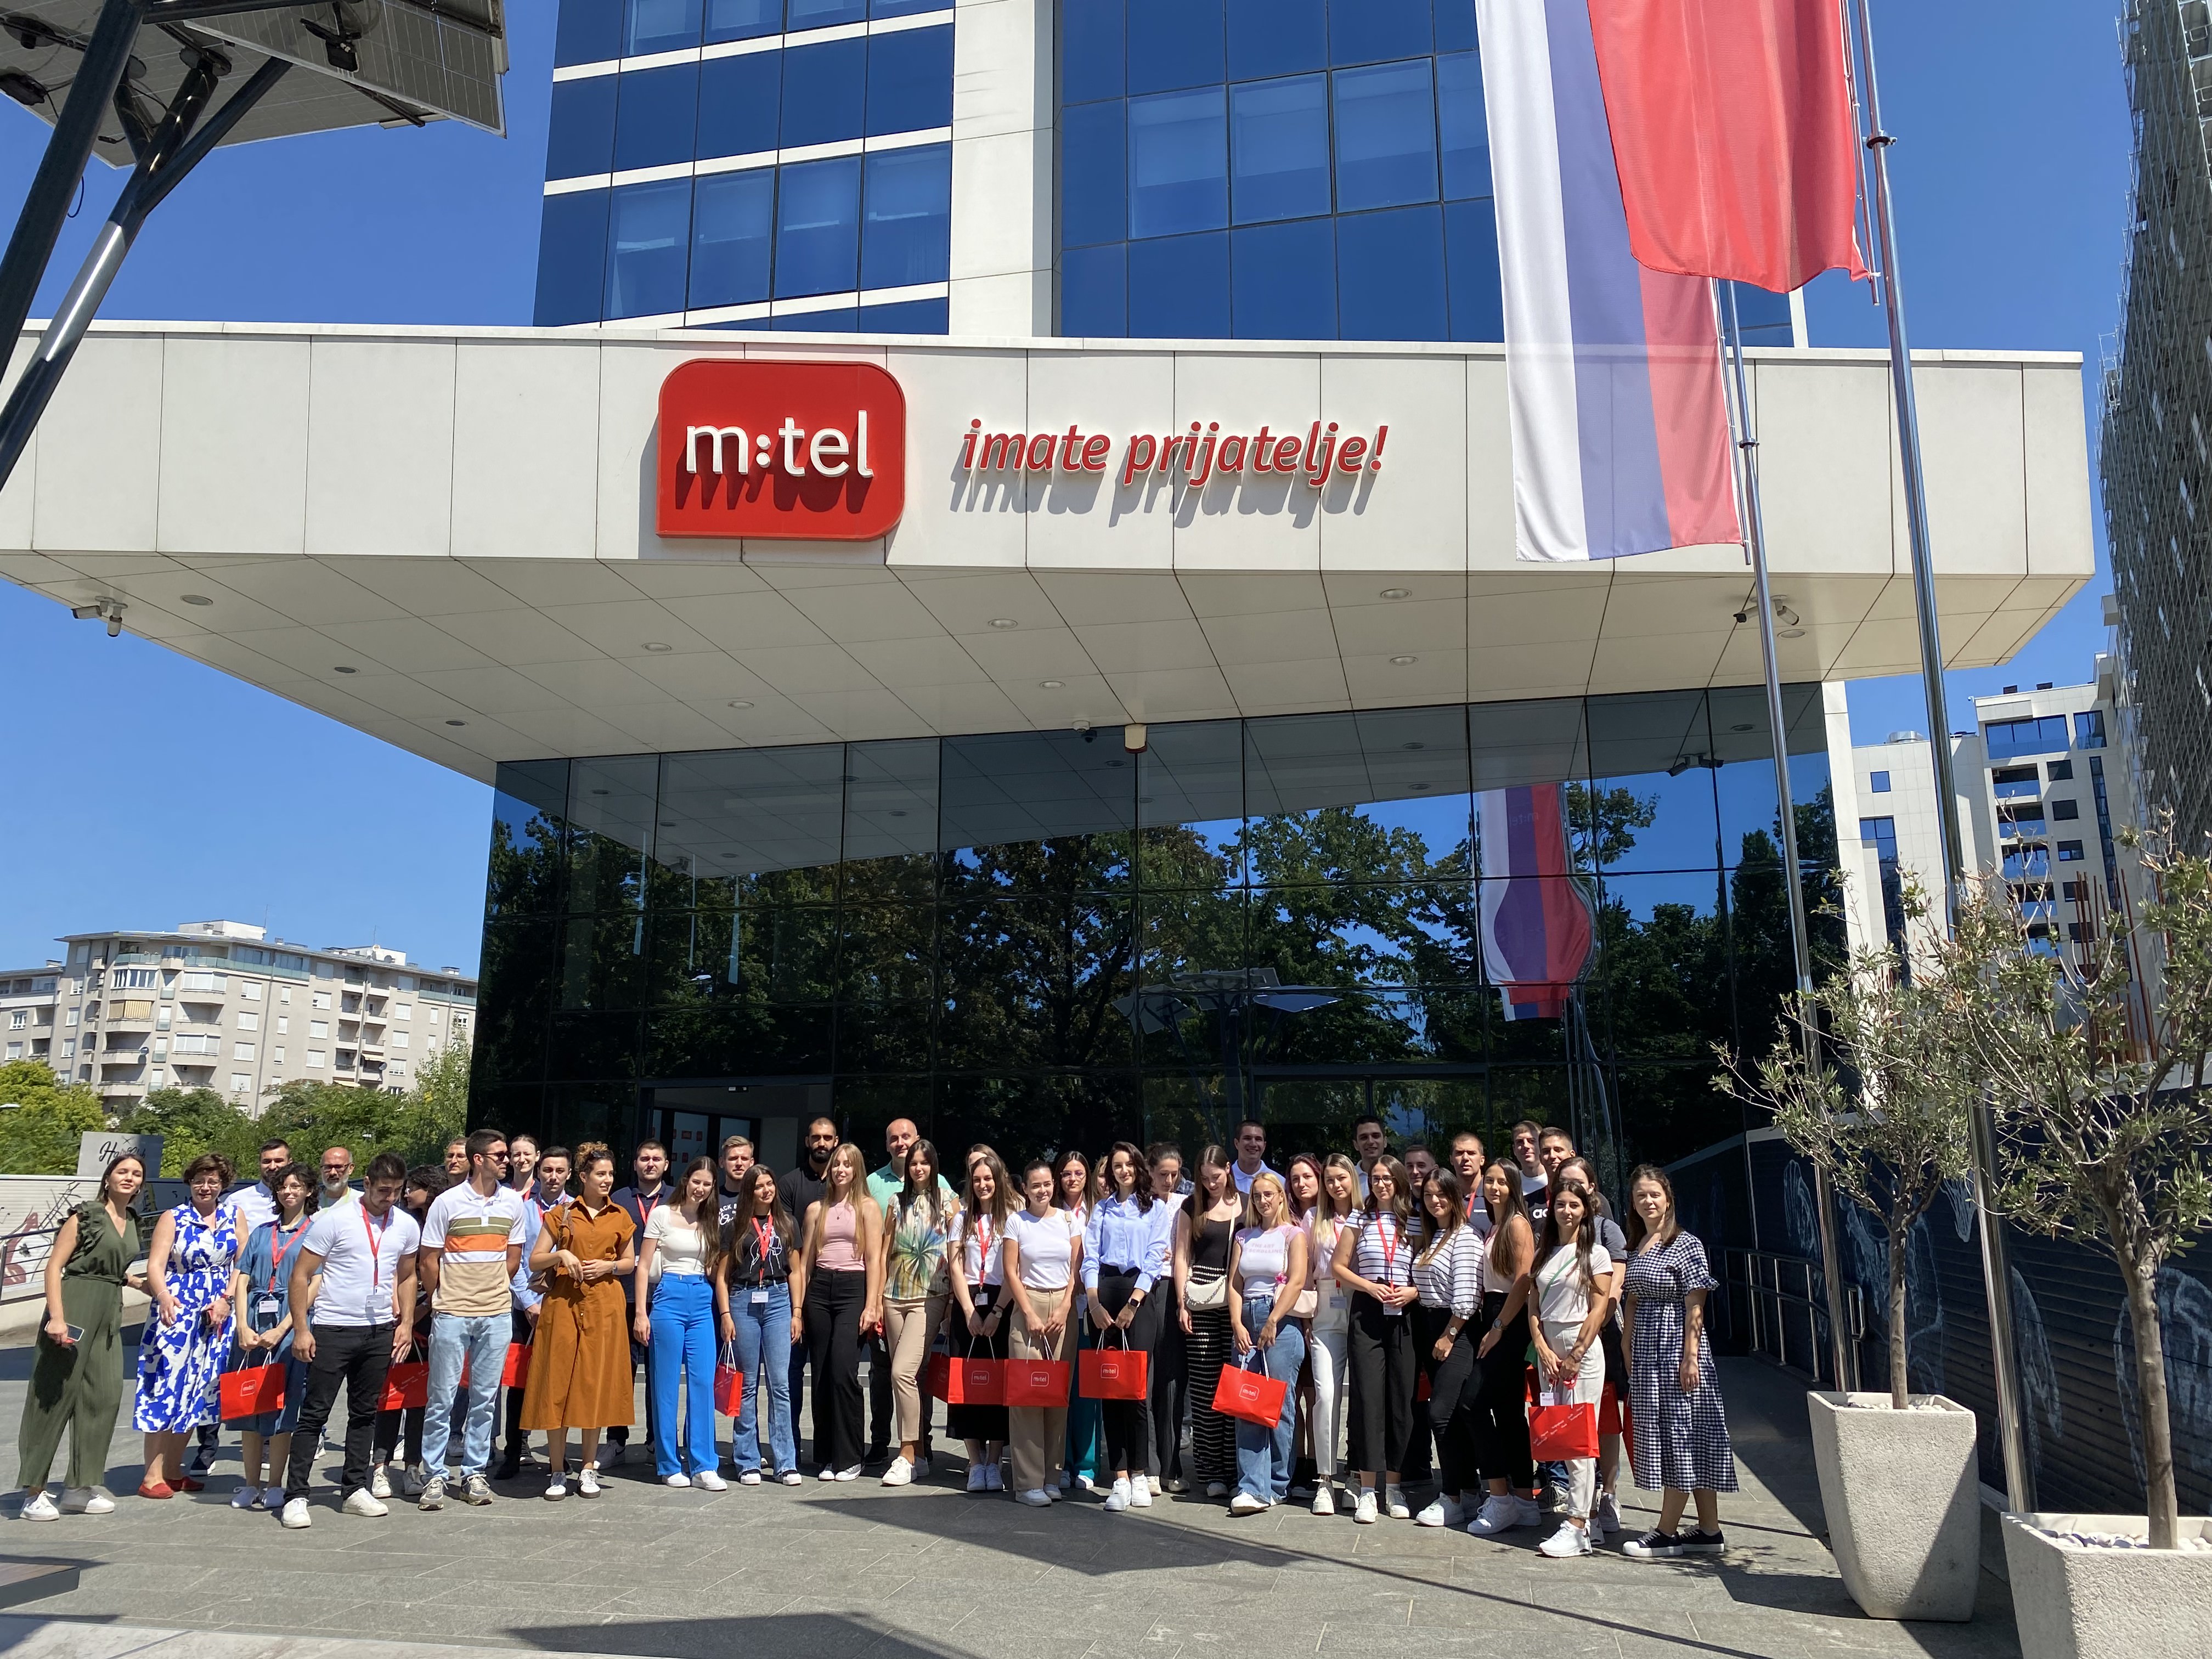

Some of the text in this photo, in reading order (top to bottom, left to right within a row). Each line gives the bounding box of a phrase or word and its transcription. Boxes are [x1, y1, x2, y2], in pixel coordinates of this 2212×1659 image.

[686, 410, 874, 478] m:tel
[963, 418, 1389, 488] imate prijatelje!
